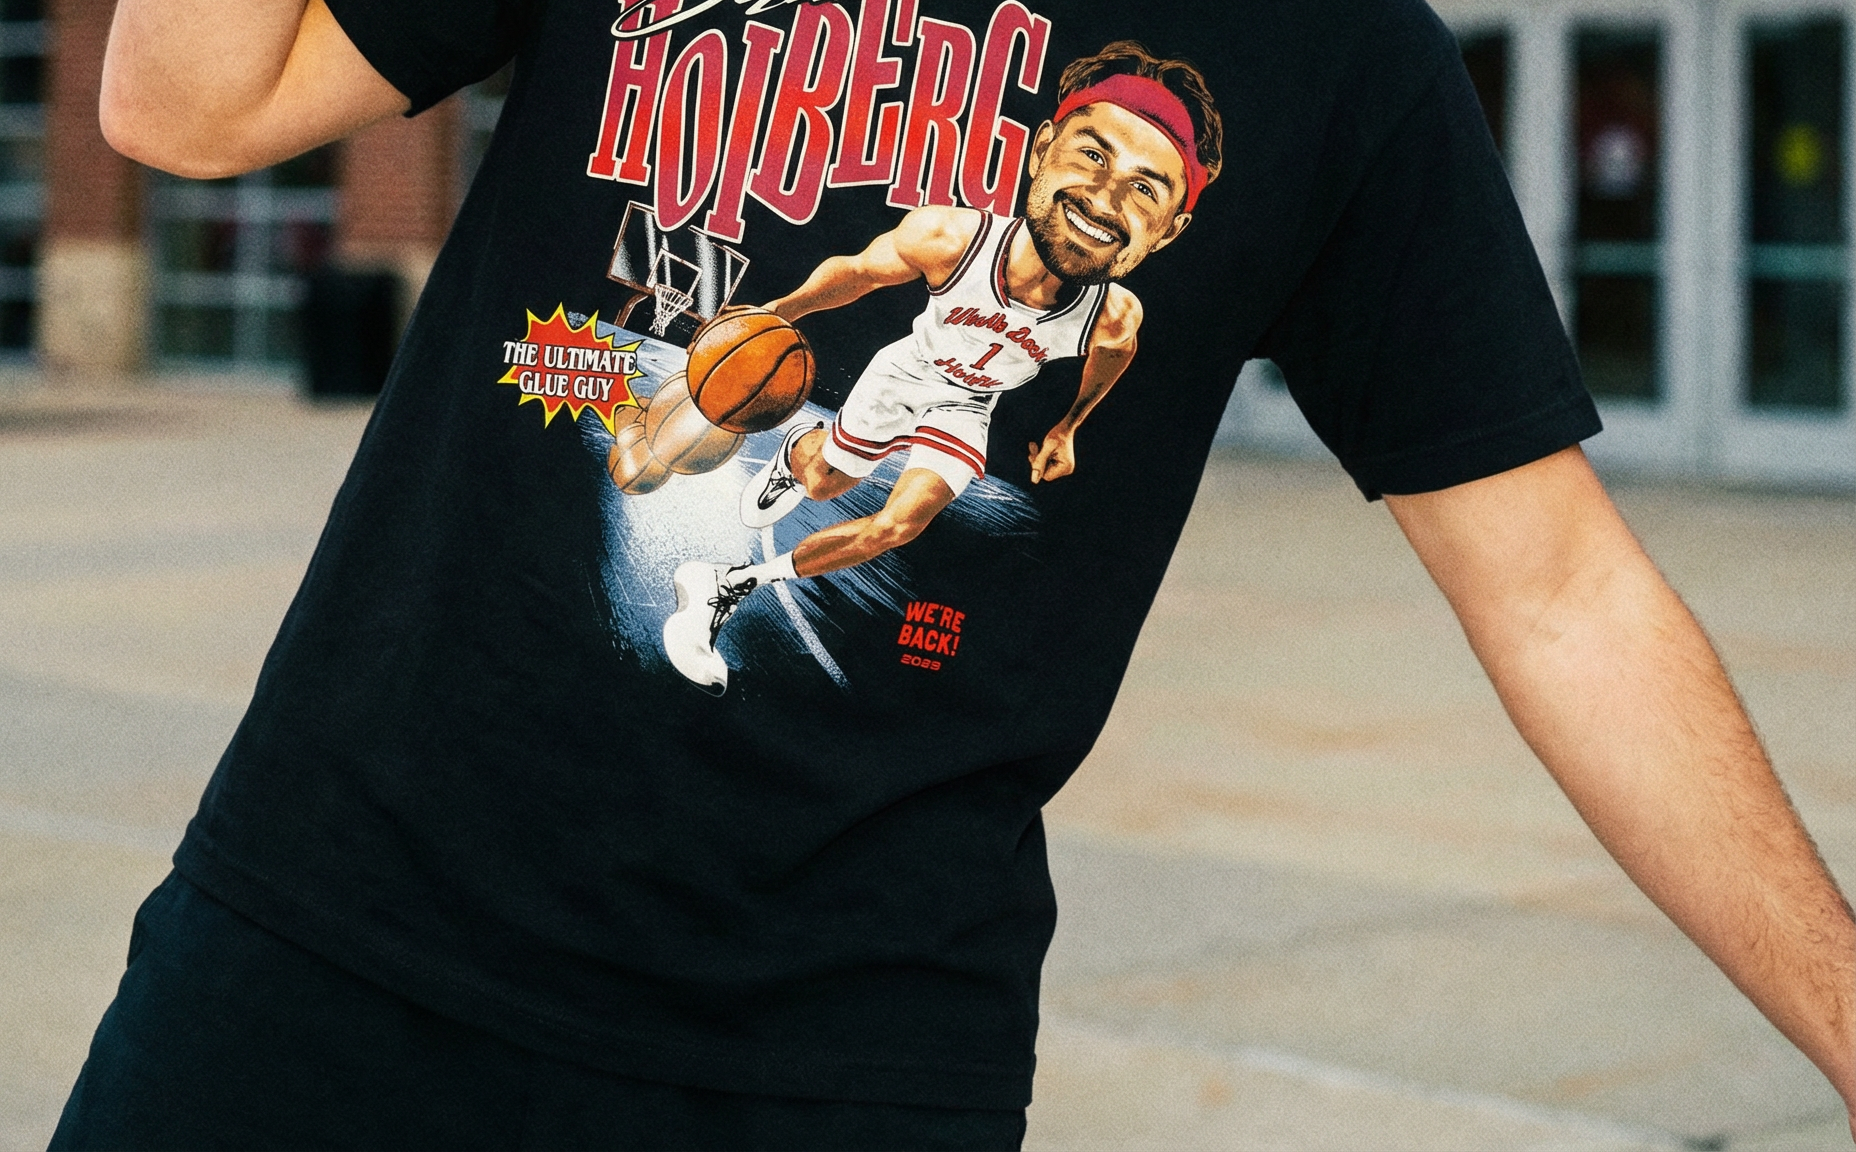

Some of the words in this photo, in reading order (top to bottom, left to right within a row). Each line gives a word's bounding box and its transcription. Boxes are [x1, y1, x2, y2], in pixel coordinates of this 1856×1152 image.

[503, 340, 539, 367] THE
[543, 344, 637, 375] ULTIMATE
[969, 342, 1004, 371] 1
[518, 370, 570, 398] GLUE
[573, 376, 615, 402] GUY
[905, 600, 966, 633] WE'RE
[897, 623, 961, 657] BACK!
